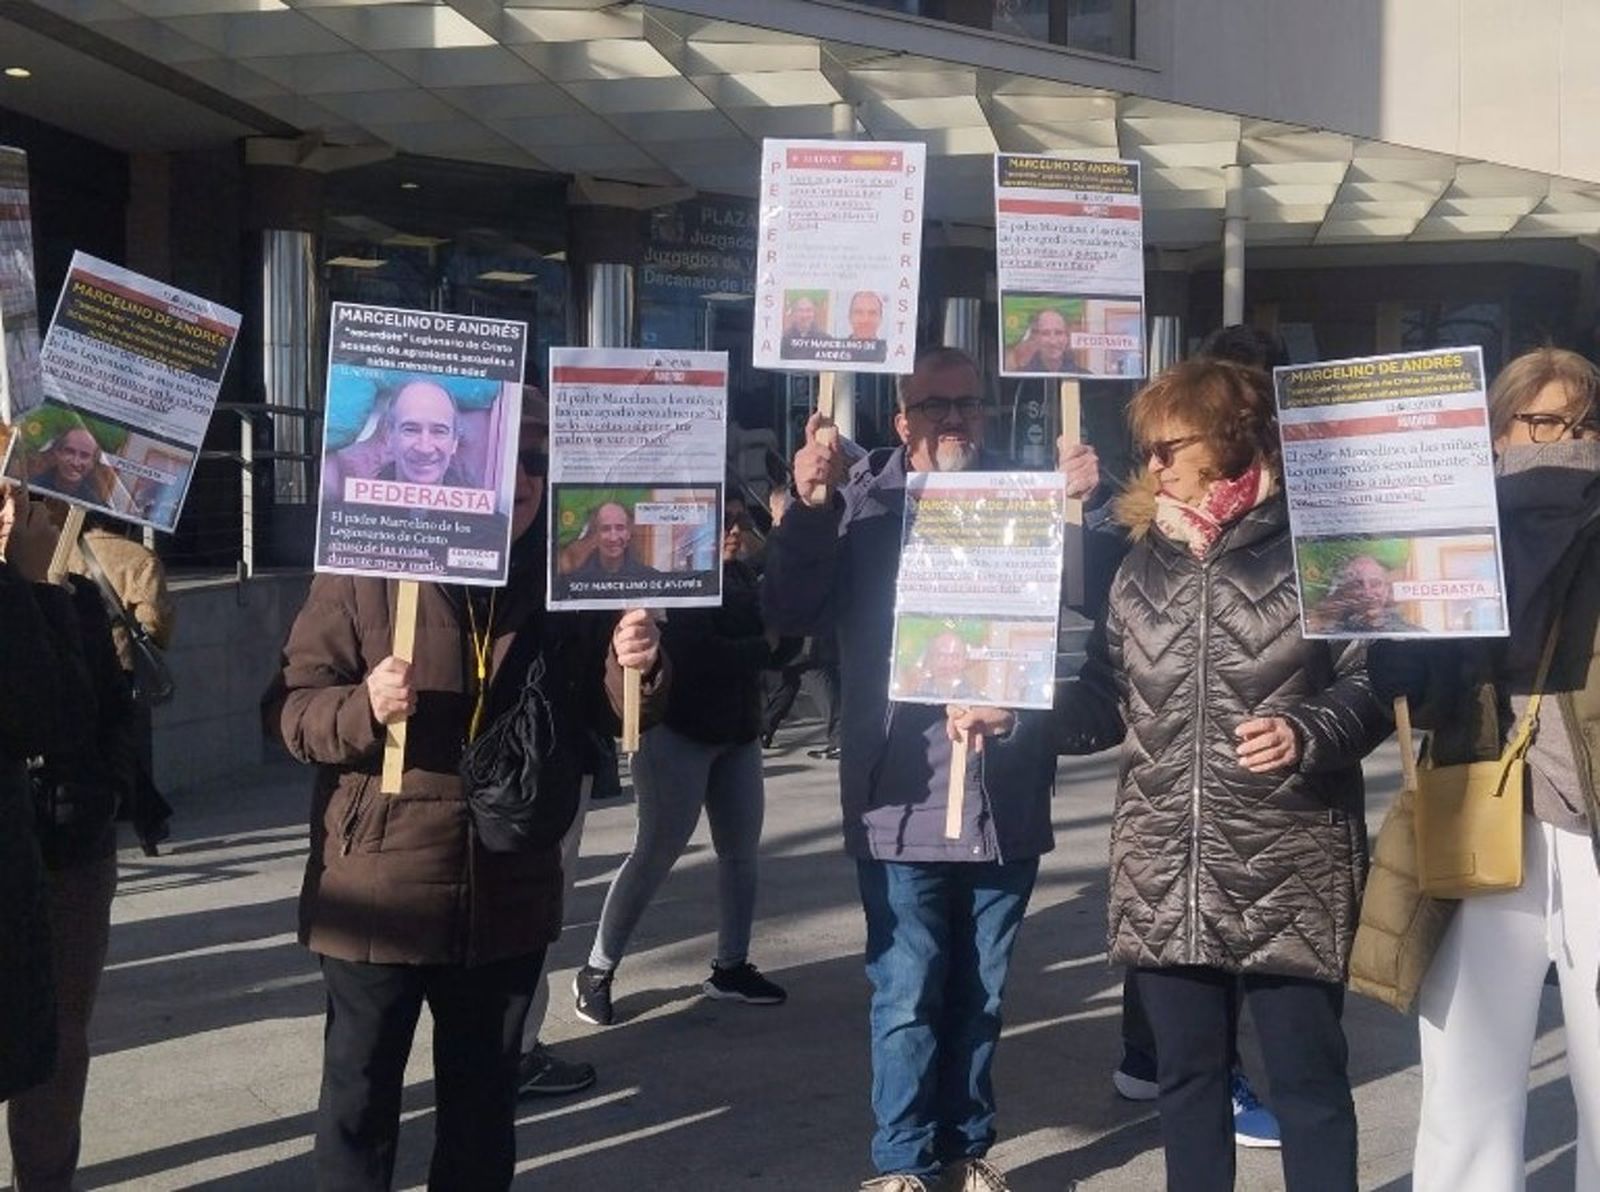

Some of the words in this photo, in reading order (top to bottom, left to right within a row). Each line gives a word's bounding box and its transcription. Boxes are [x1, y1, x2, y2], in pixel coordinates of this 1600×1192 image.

[1008, 159, 1070, 172] MARCELINO
[1072, 162, 1086, 172] DE
[71, 280, 153, 321] MARCELINO
[153, 311, 174, 328] DE
[173, 318, 228, 349] ANDRÉS
[339, 308, 431, 330] MARCELINO
[434, 317, 456, 332] DE
[457, 319, 521, 340] ANDRÉS
[1290, 364, 1376, 384] MARCELINO
[1378, 361, 1398, 376] DE
[1399, 354, 1464, 373] ANDRÉS
[354, 482, 490, 511] PEDERASTA
[331, 511, 343, 524] El
[344, 513, 378, 527] padre
[380, 515, 438, 530] Marcelino
[438, 519, 453, 532] de
[454, 520, 472, 534] los
[329, 525, 396, 541] Legionarios
[397, 530, 411, 542] de
[413, 532, 449, 545] Cristo
[569, 582, 590, 592] SOY
[592, 581, 648, 591] MARCELINO
[649, 580, 662, 590] DE
[664, 578, 703, 590] ANDRÉS
[1401, 582, 1486, 598] PEDERASTA
